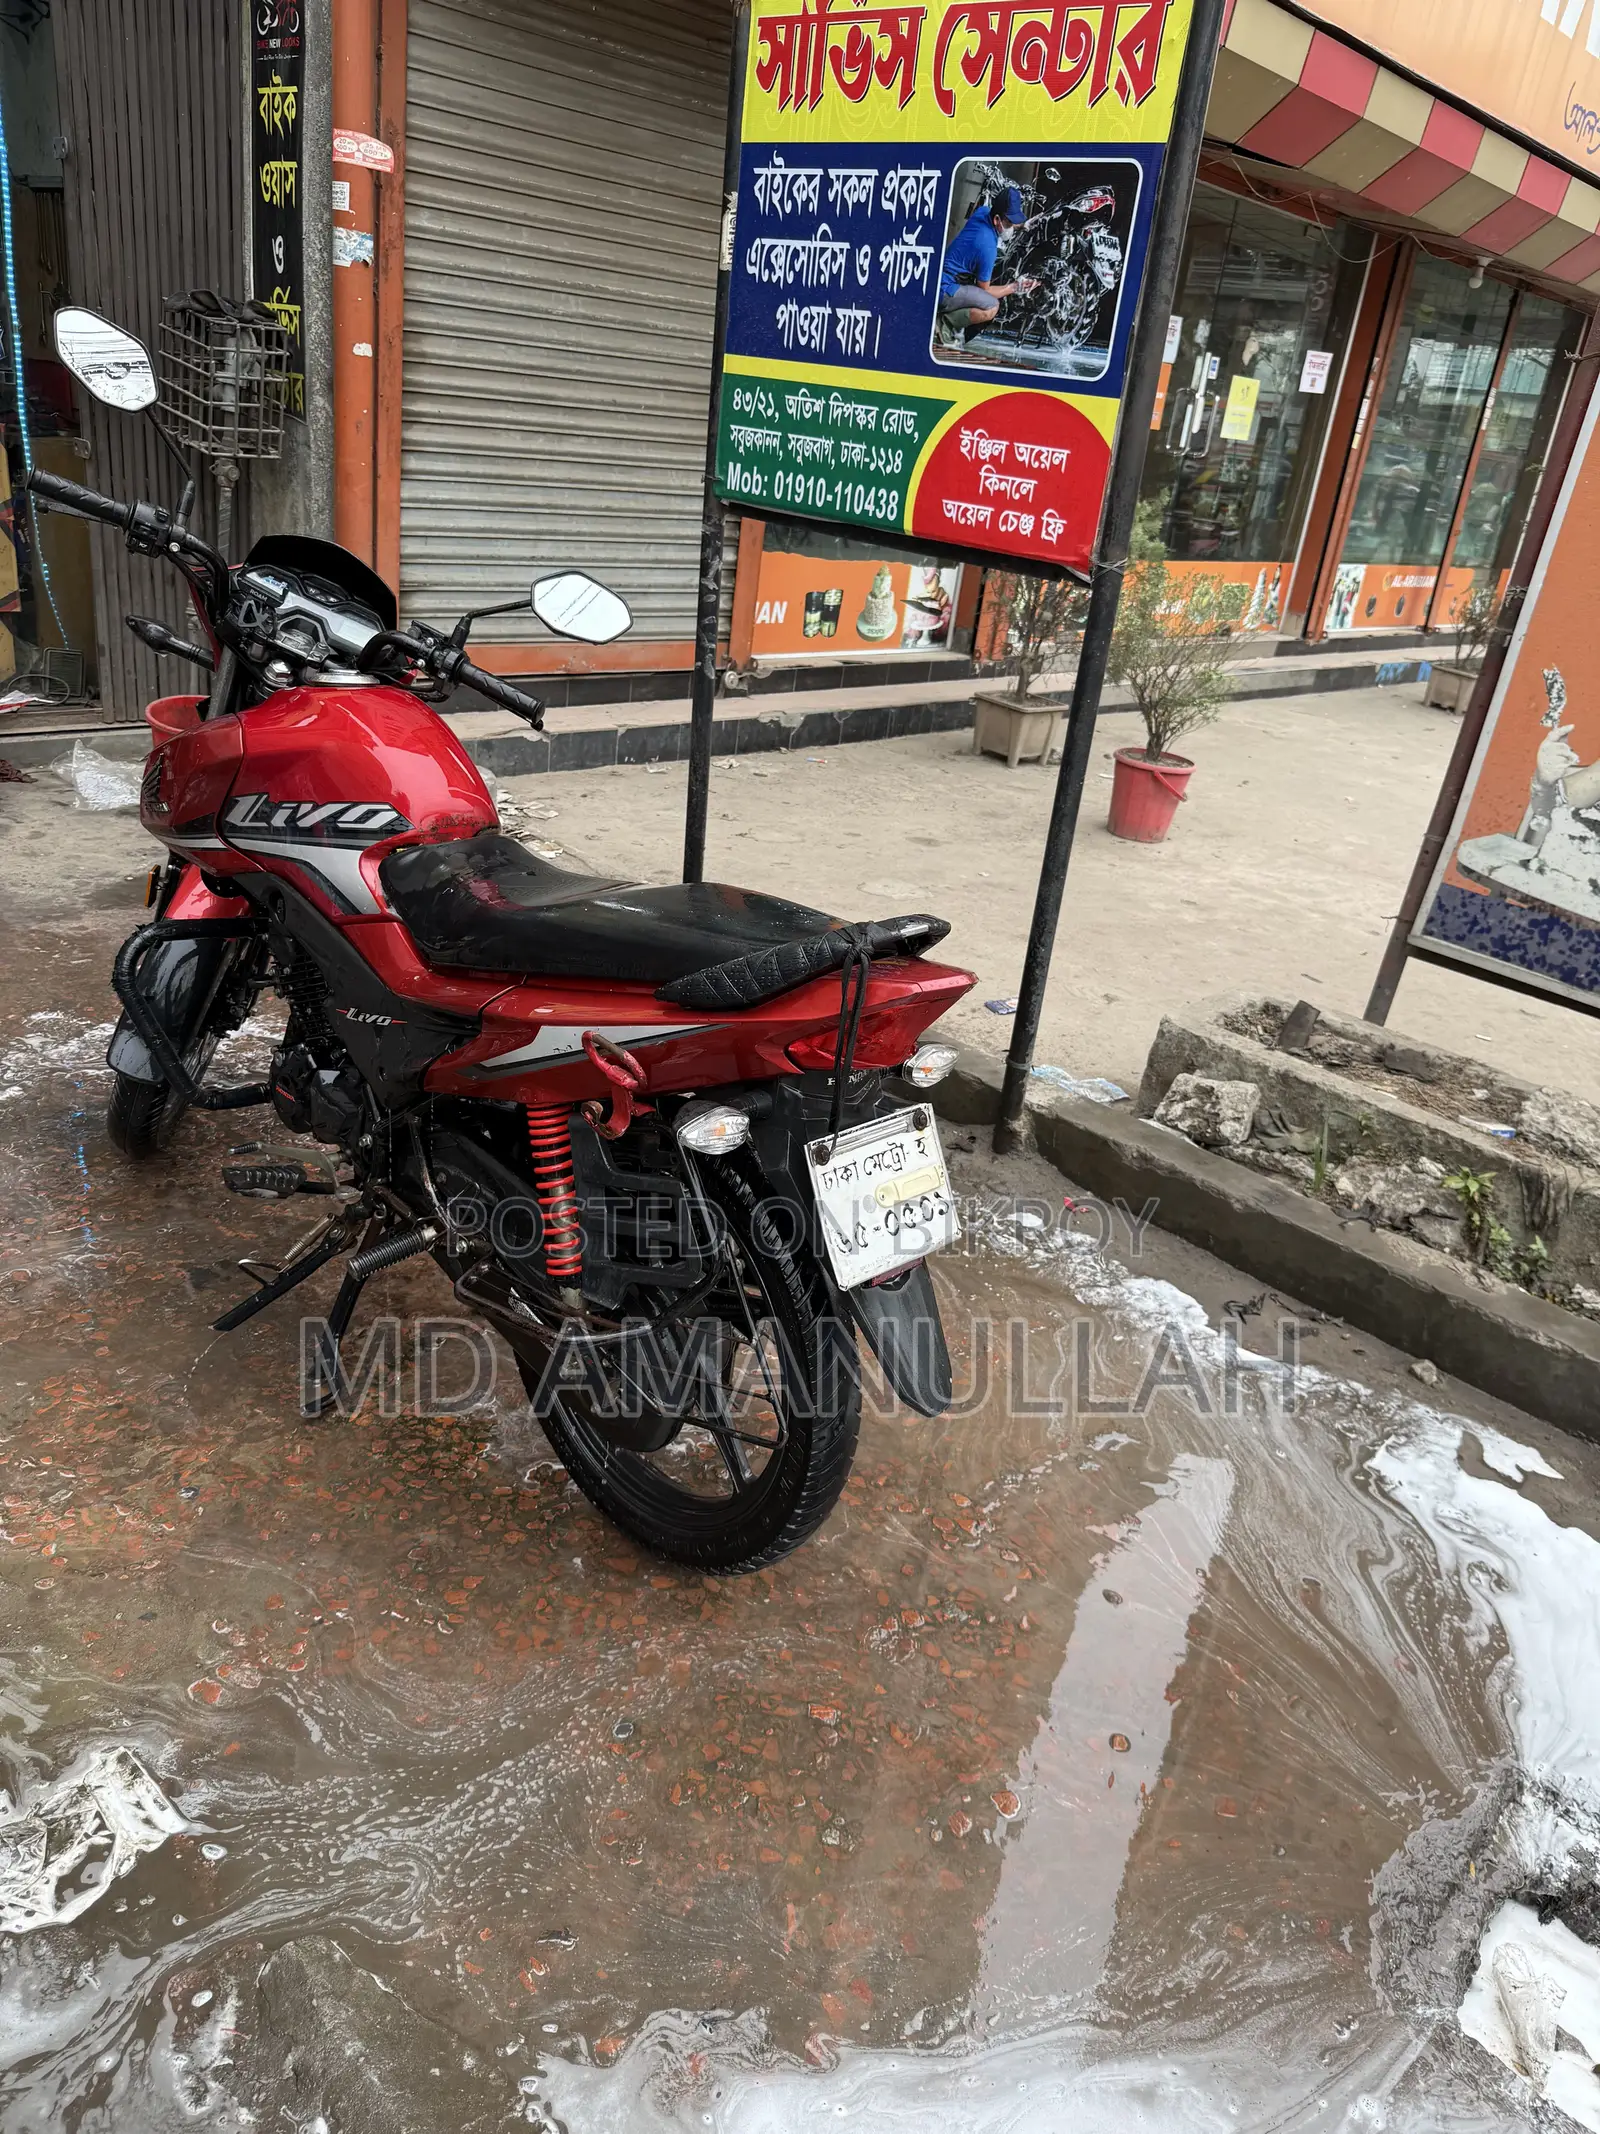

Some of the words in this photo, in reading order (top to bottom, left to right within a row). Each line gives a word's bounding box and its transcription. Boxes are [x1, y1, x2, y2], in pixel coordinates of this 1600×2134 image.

[934, 0, 1172, 117] সেন্টার
[257, 69, 298, 140] বাইক
[260, 154, 298, 208] ওয়াস
[753, 150, 824, 221] বাইকের
[828, 169, 879, 218] সকল
[882, 162, 942, 222] প্রকার
[272, 235, 284, 274] ও
[856, 245, 871, 286] ও
[879, 225, 935, 296] পার্টস
[776, 298, 832, 354] পাওয়া
[732, 386, 780, 424] ৪৩/২১,
[785, 388, 826, 424] অতিশ
[882, 406, 920, 444] রোড,
[729, 424, 783, 462] সবুজকানন,
[787, 433, 836, 471] সবুজবাগ,
[840, 440, 904, 477] ঢাকা-১২১৪
[1013, 442, 1071, 473] অয়েল
[727, 462, 769, 497] Mob:
[774, 470, 900, 521] 01910-110438
[979, 464, 1038, 503] কিনলে
[942, 499, 995, 529] অয়েল
[998, 510, 1035, 537] চেঞ্জ
[1041, 508, 1067, 545] ফ্রি
[249, 588, 268, 602] ROAM
[225, 793, 399, 829] Livo
[345, 1007, 393, 1026] Livo
[821, 1160, 860, 1190] ঢাকা
